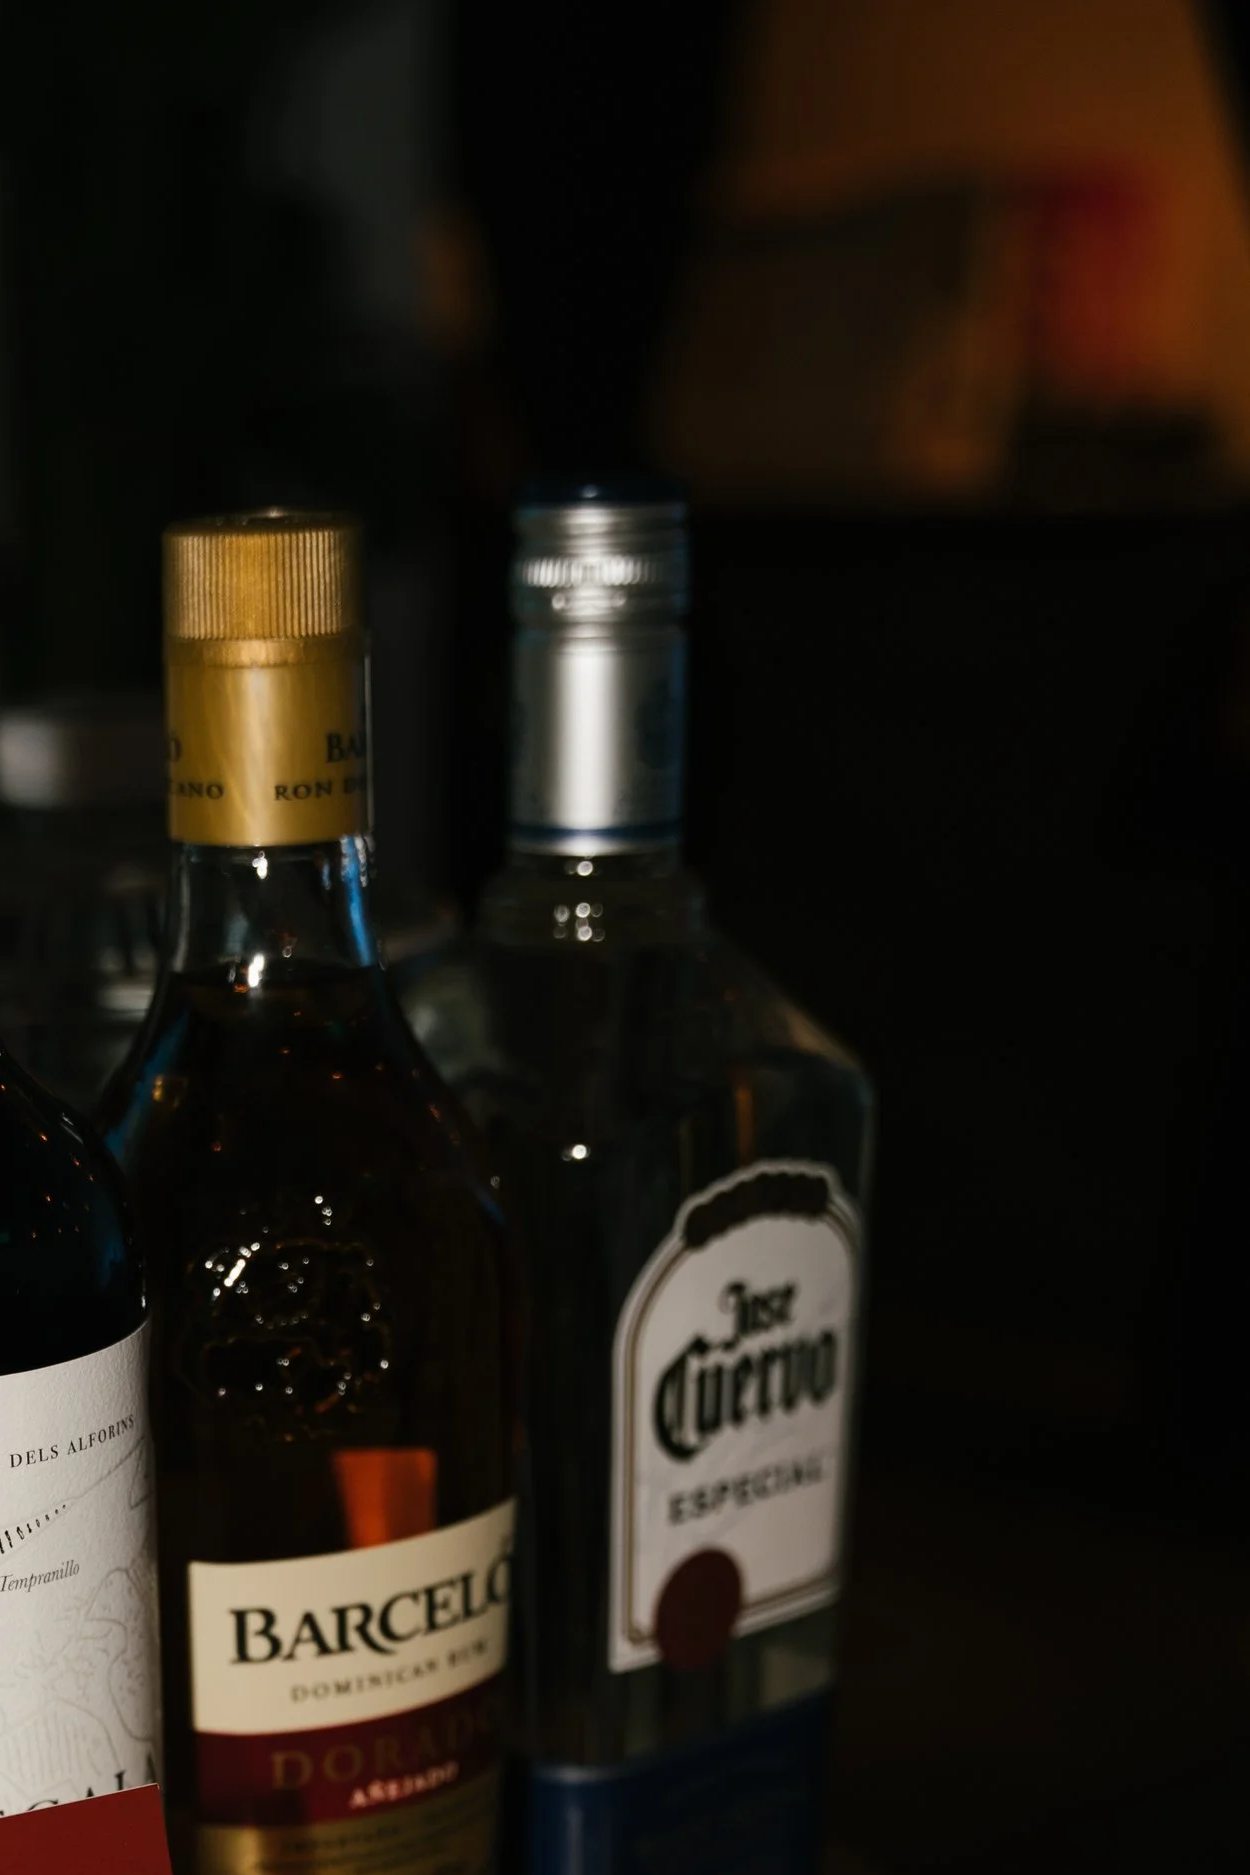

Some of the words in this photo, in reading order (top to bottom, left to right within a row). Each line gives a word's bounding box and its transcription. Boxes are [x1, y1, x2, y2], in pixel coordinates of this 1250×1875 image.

[653, 1331, 837, 1467] Cuervo
[10, 1444, 60, 1469] DELS
[67, 1413, 135, 1455] ALFORINS
[668, 1455, 824, 1526] ESPECIAL
[290, 1660, 438, 1704] DOMINICAN
[449, 1637, 490, 1670] RUM
